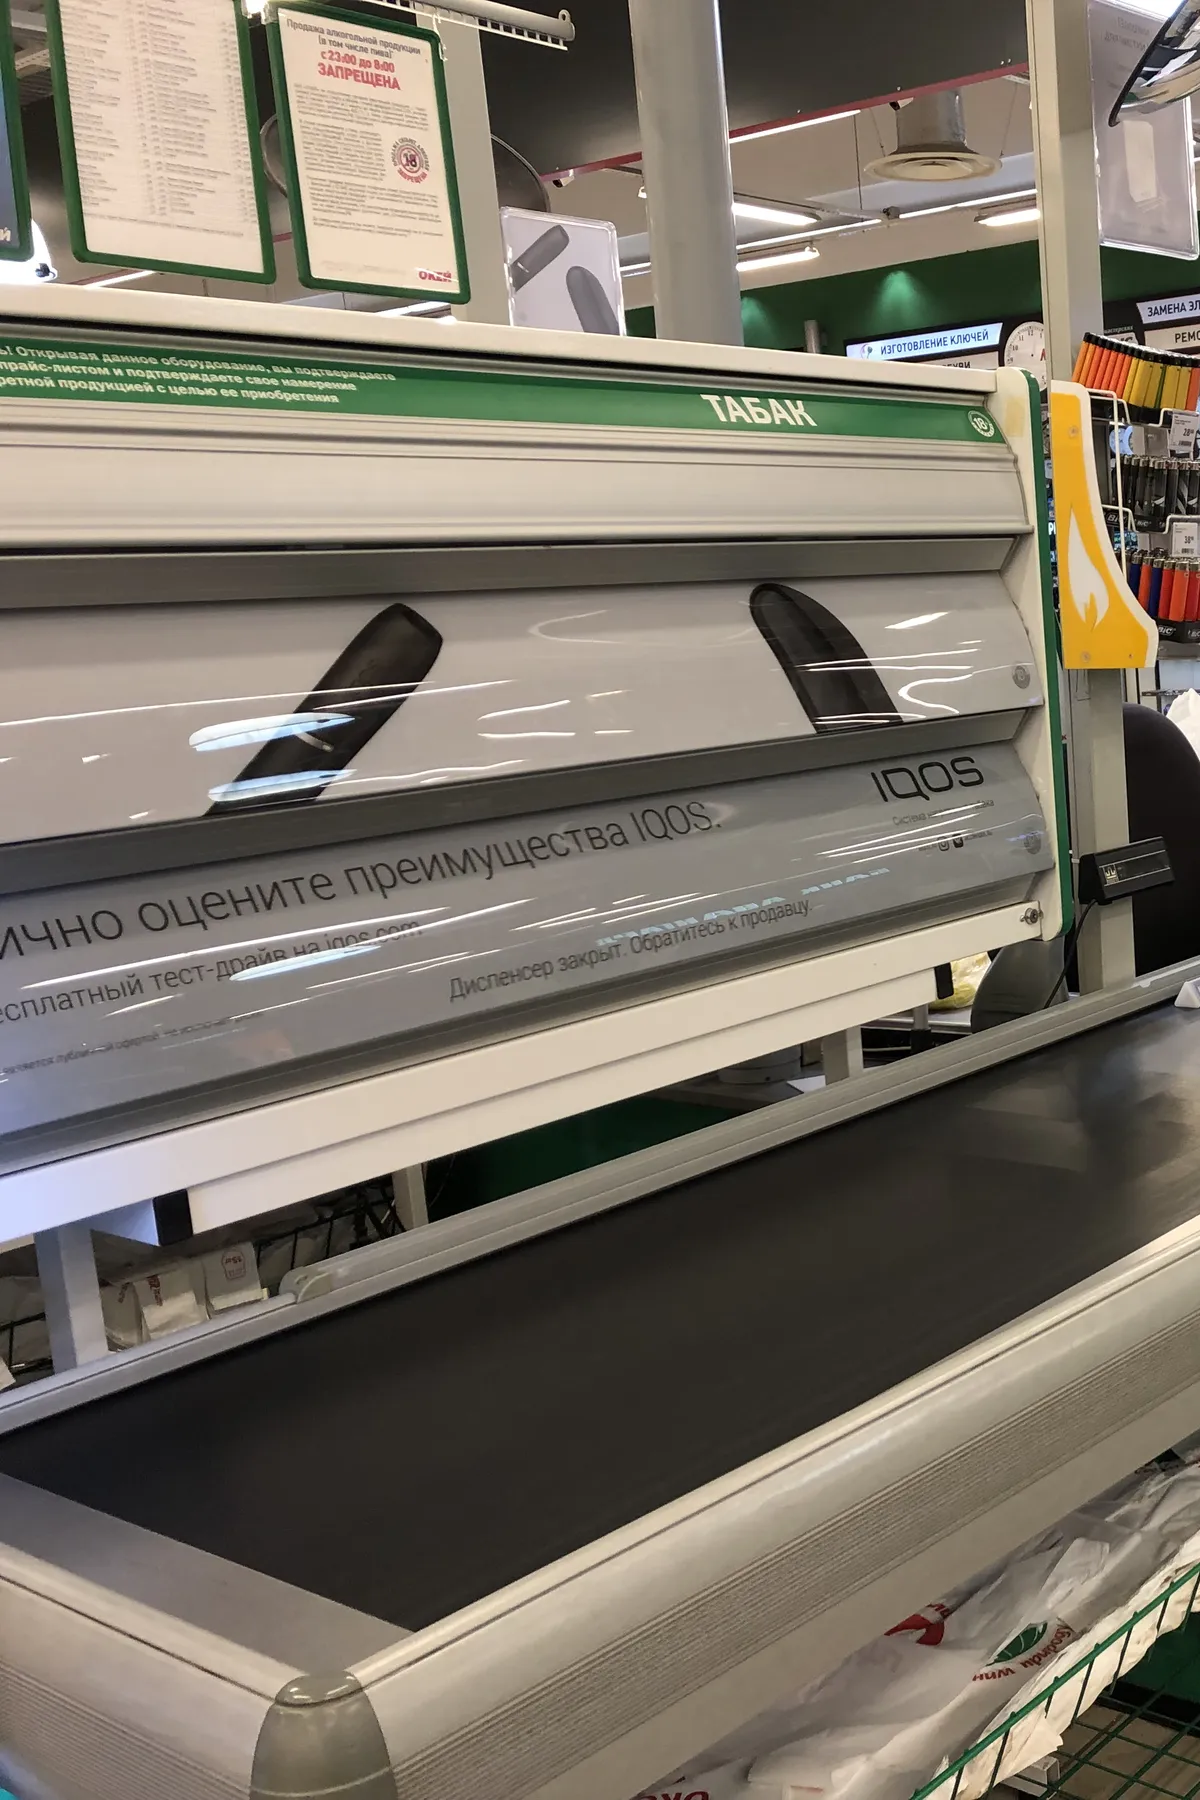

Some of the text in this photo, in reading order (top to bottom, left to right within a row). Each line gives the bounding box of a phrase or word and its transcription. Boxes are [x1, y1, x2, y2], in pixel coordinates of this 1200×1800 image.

[287, 18, 421, 54] Продажа алкогольной продукции
[328, 40, 343, 49] том
[345, 42, 369, 54] числе
[318, 63, 401, 90] ЗАПРЕЩЕНА
[321, 50, 395, 73] с 23:00 до 8:00
[1147, 304, 1187, 317] ЗАМЕНА
[880, 328, 990, 356] ИЗГОТОВЛЕНИЕ КЛЮЧЕЙ
[16, 346, 100, 361] Открывая
[102, 353, 159, 365] данное
[161, 357, 272, 374] оборудование,
[272, 364, 293, 374] вы
[294, 366, 396, 381] подтверждаете
[113, 367, 124, 376] и
[126, 368, 244, 384] подтверждаете
[245, 375, 279, 386] свое
[281, 378, 357, 391] намерение
[0, 376, 340, 403] ретной продукцией с целью ее приобретения
[700, 393, 818, 427] ТАБАК
[869, 756, 985, 804] IQOS
[0, 800, 722, 961] ично оцените преимущества IQOS.
[449, 957, 554, 1004] Диспенсер
[558, 942, 628, 979] закрыт.
[630, 920, 725, 957] Обратитесь
[727, 917, 739, 932] к
[740, 898, 814, 933] продавцу.
[0, 972, 145, 1024] есплатный
[148, 945, 288, 993] тест-драйв
[293, 940, 322, 958] на
